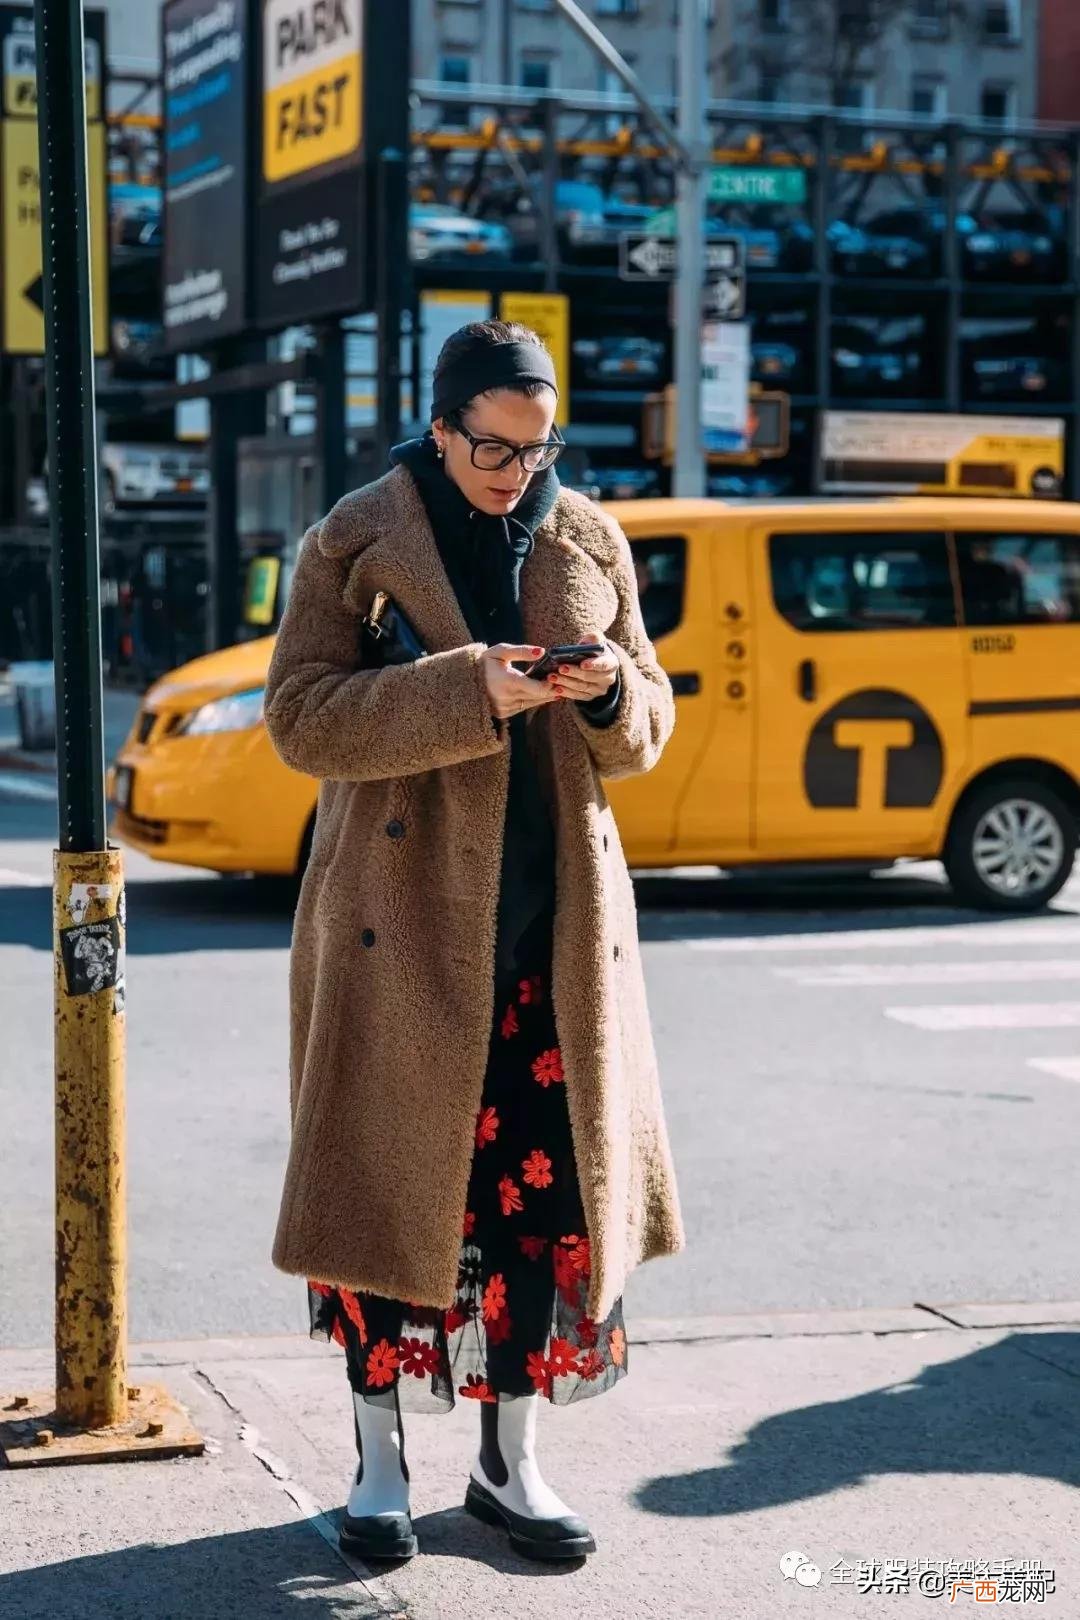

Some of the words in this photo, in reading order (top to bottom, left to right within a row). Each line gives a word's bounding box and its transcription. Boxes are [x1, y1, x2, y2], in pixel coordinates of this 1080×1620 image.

[276, 0, 350, 69] PARK
[275, 73, 350, 154] FAST
[833, 719, 914, 810] T
